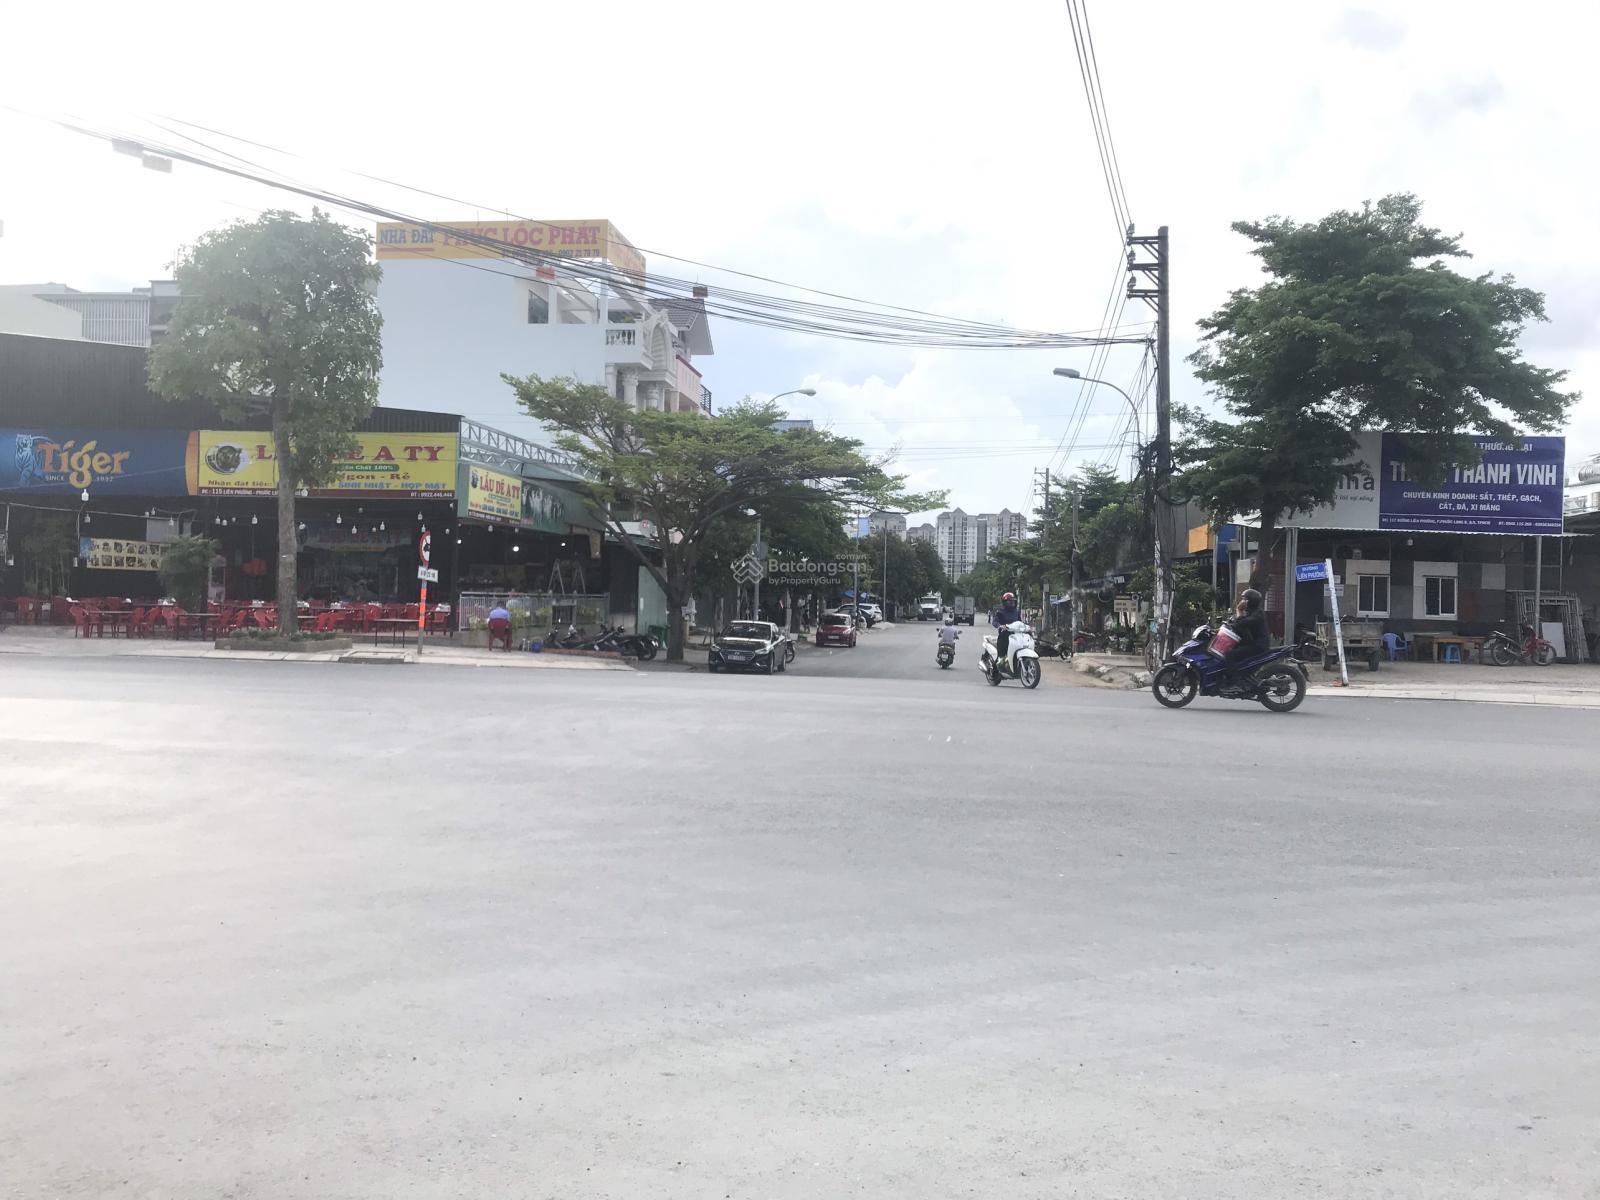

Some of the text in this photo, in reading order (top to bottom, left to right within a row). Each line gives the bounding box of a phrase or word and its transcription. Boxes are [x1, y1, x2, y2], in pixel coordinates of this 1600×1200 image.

[373, 446, 395, 460] A
[403, 446, 445, 460] TY
[38, 440, 130, 489] Tiger
[1517, 463, 1558, 486] VINH
[1403, 491, 1431, 499] CHUYÊN
[1433, 492, 1450, 500] KINH
[1451, 492, 1478, 500] DOANH:
[1520, 494, 1542, 503] GẠCH,
[1471, 503, 1478, 511] XI
